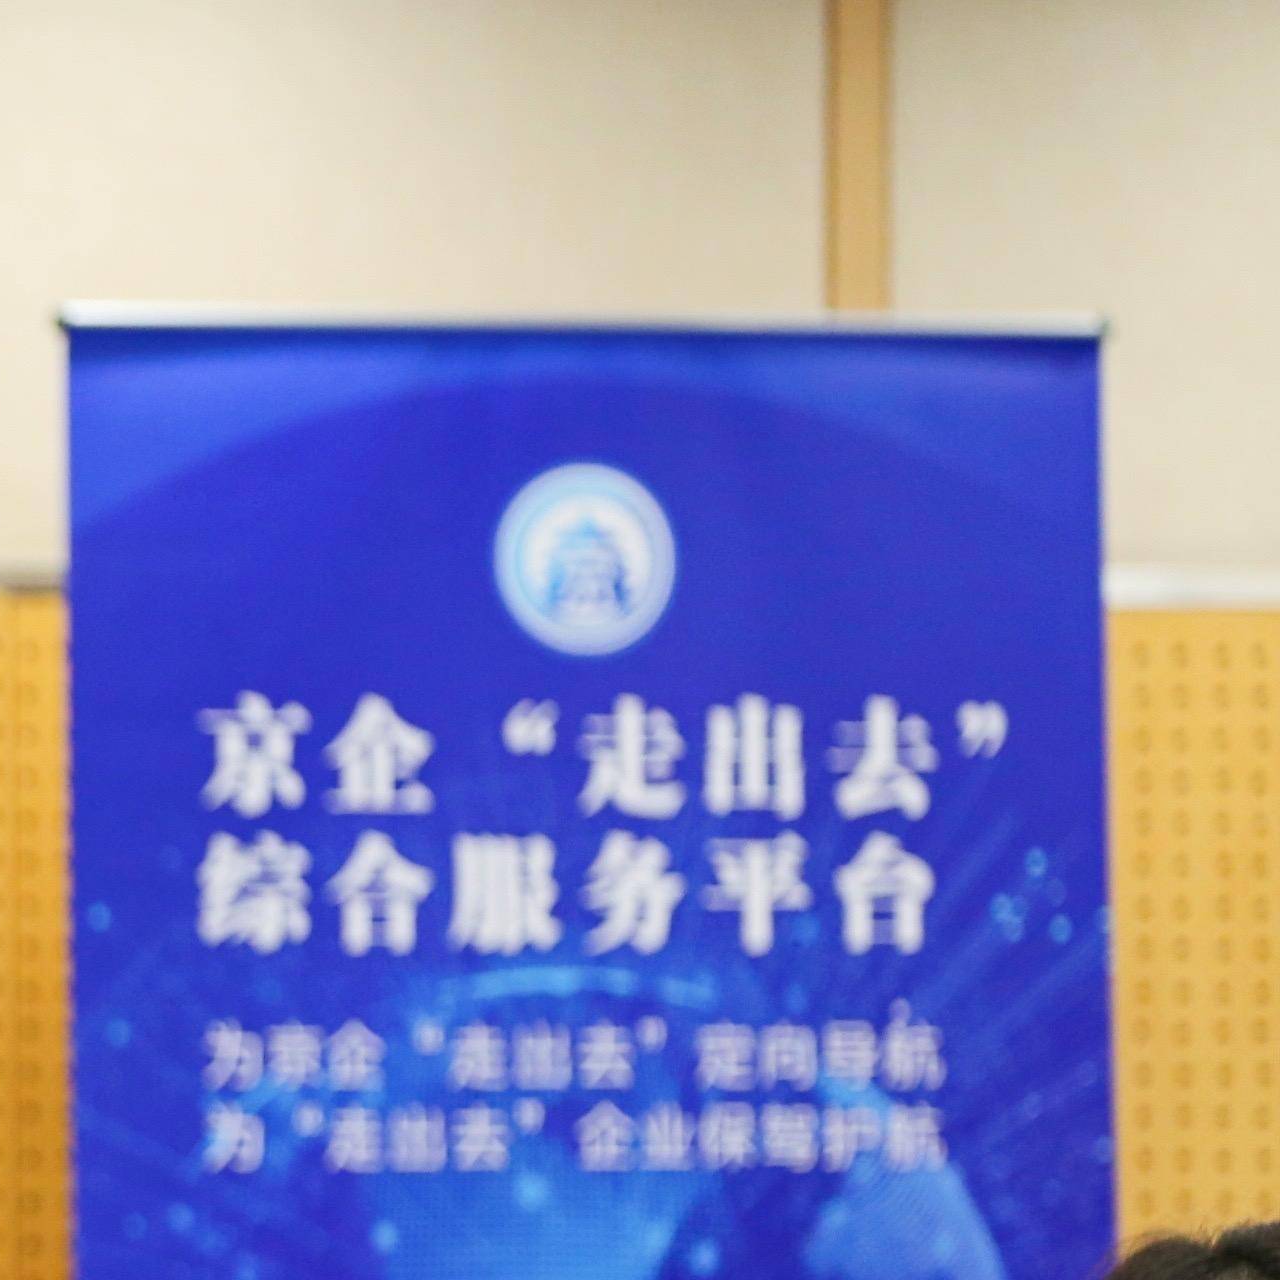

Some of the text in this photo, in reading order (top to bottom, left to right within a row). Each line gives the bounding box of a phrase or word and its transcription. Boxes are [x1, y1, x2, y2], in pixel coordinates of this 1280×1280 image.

[196, 829, 935, 955] 综合服务平台
